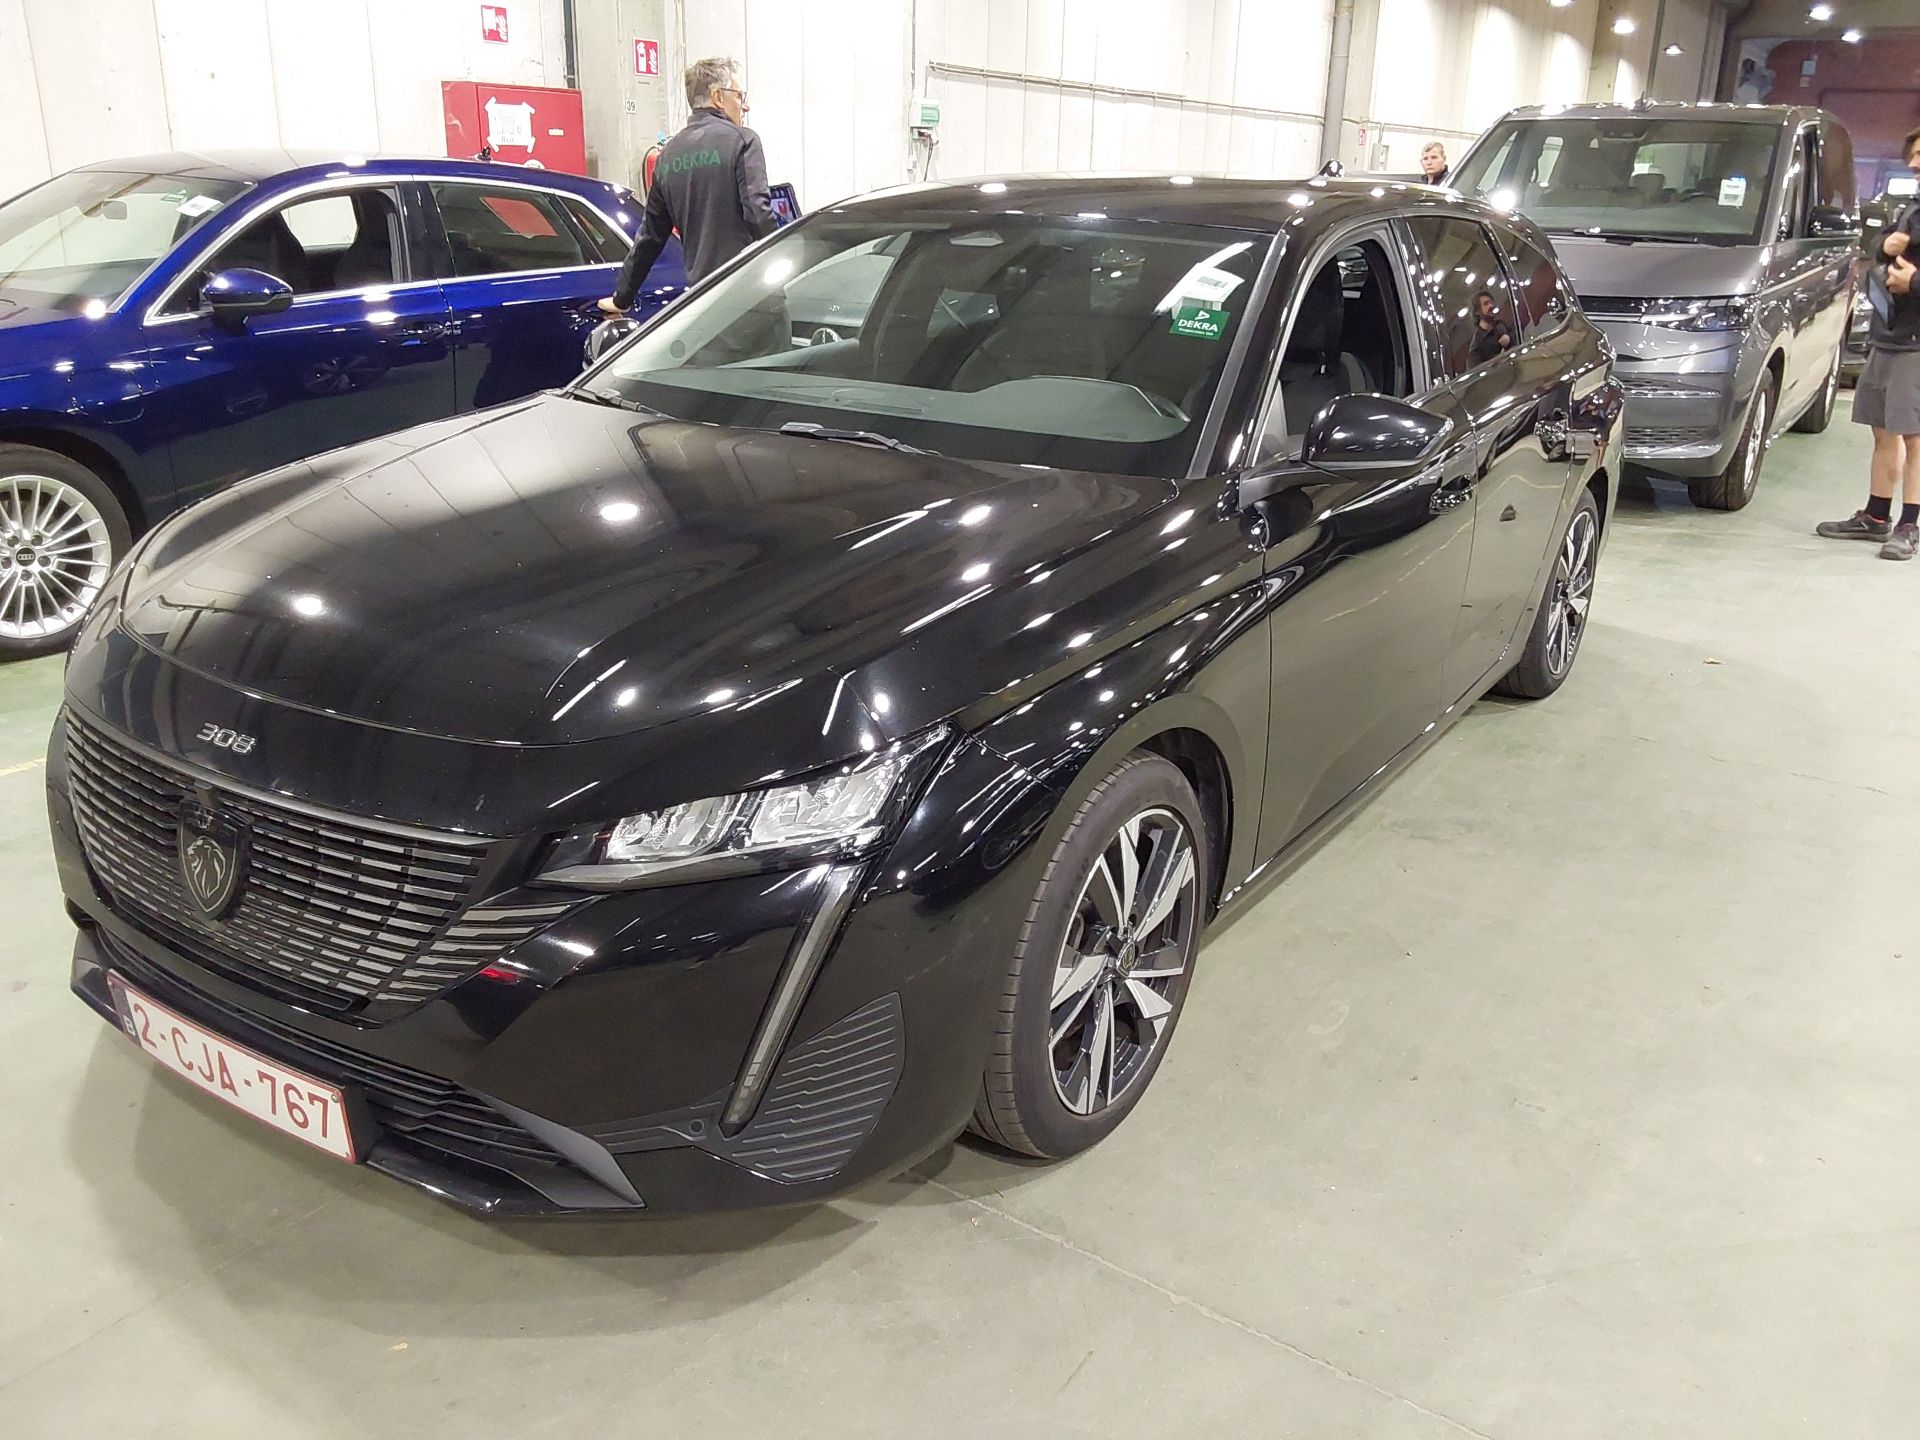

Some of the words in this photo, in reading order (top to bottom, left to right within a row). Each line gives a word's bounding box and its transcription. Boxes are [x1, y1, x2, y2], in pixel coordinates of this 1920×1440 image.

[626, 100, 636, 111] 39
[673, 150, 721, 172] DEKRA
[1178, 319, 1218, 332] DEKRA
[196, 722, 255, 753] 308
[122, 1014, 136, 1036] B
[134, 1003, 329, 1138] 2-CJA-767
